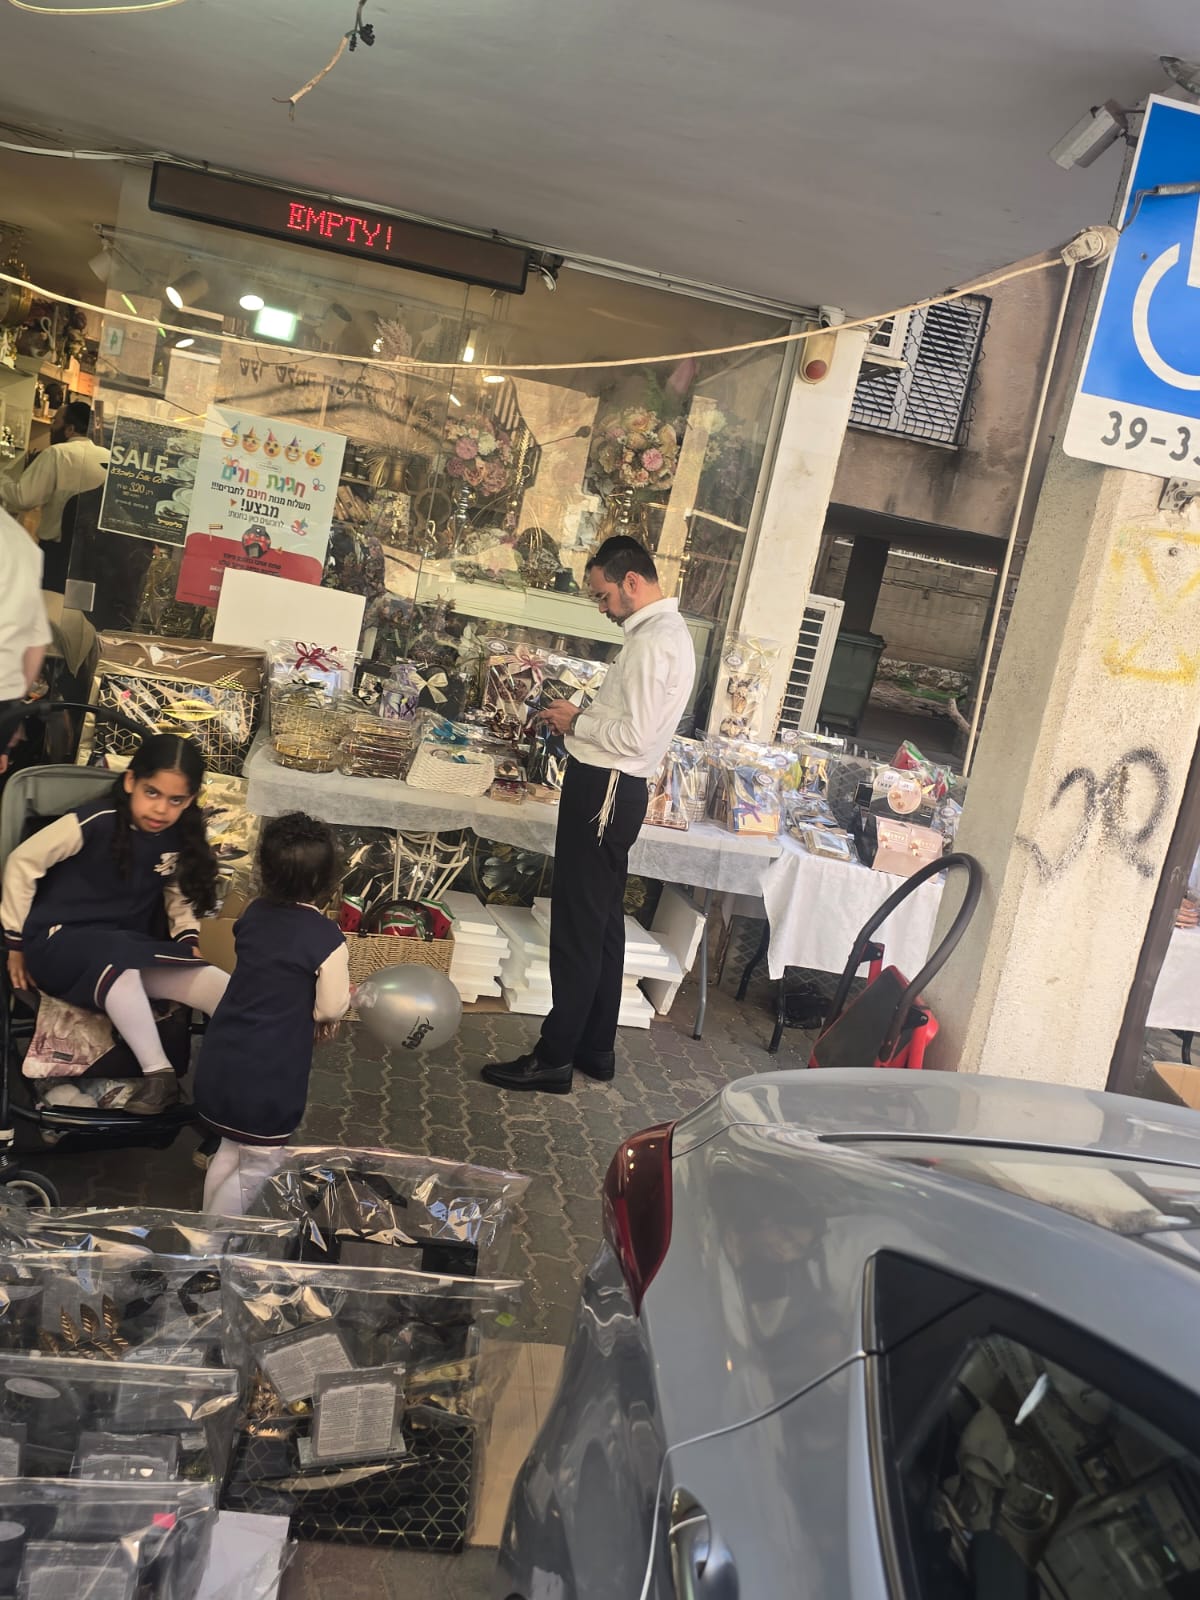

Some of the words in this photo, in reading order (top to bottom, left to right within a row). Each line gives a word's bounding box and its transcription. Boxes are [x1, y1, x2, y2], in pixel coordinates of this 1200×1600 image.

[287, 202, 392, 250] EMPTY!
[1100, 410, 1200, 466] 39-3
[111, 445, 168, 473] SALE
[221, 465, 259, 487] פורים
[266, 473, 305, 498] חגיגת
[247, 488, 267, 500] חינם
[269, 495, 286, 505] מנות
[240, 498, 279, 518] מבצע!
[287, 500, 311, 511] משלוח
